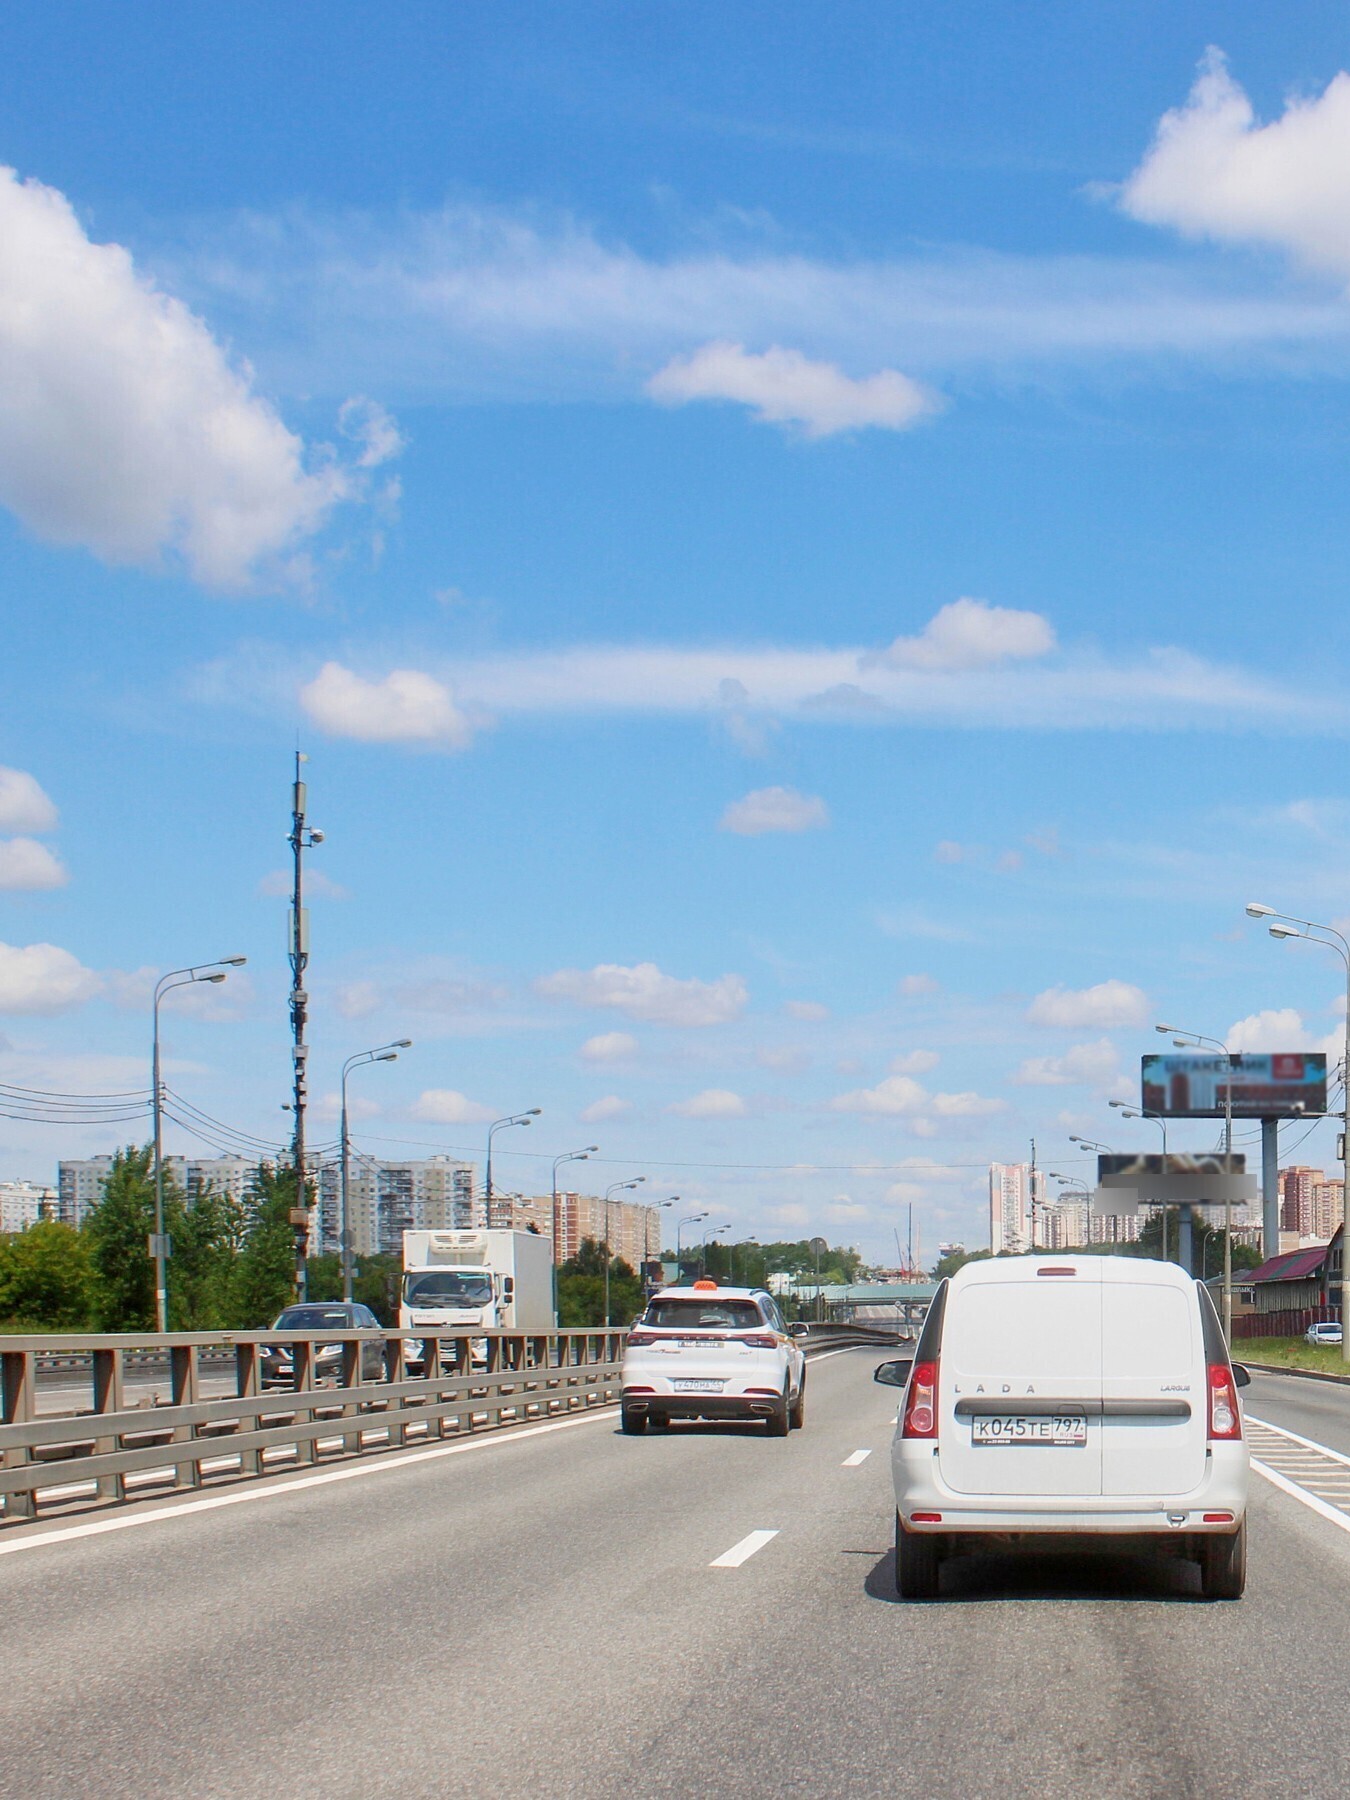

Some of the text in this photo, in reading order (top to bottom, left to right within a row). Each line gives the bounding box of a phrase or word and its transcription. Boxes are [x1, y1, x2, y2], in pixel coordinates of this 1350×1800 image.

[954, 1384, 1035, 1394] LADA
[979, 1418, 1081, 1436] К045ТЕ 797
